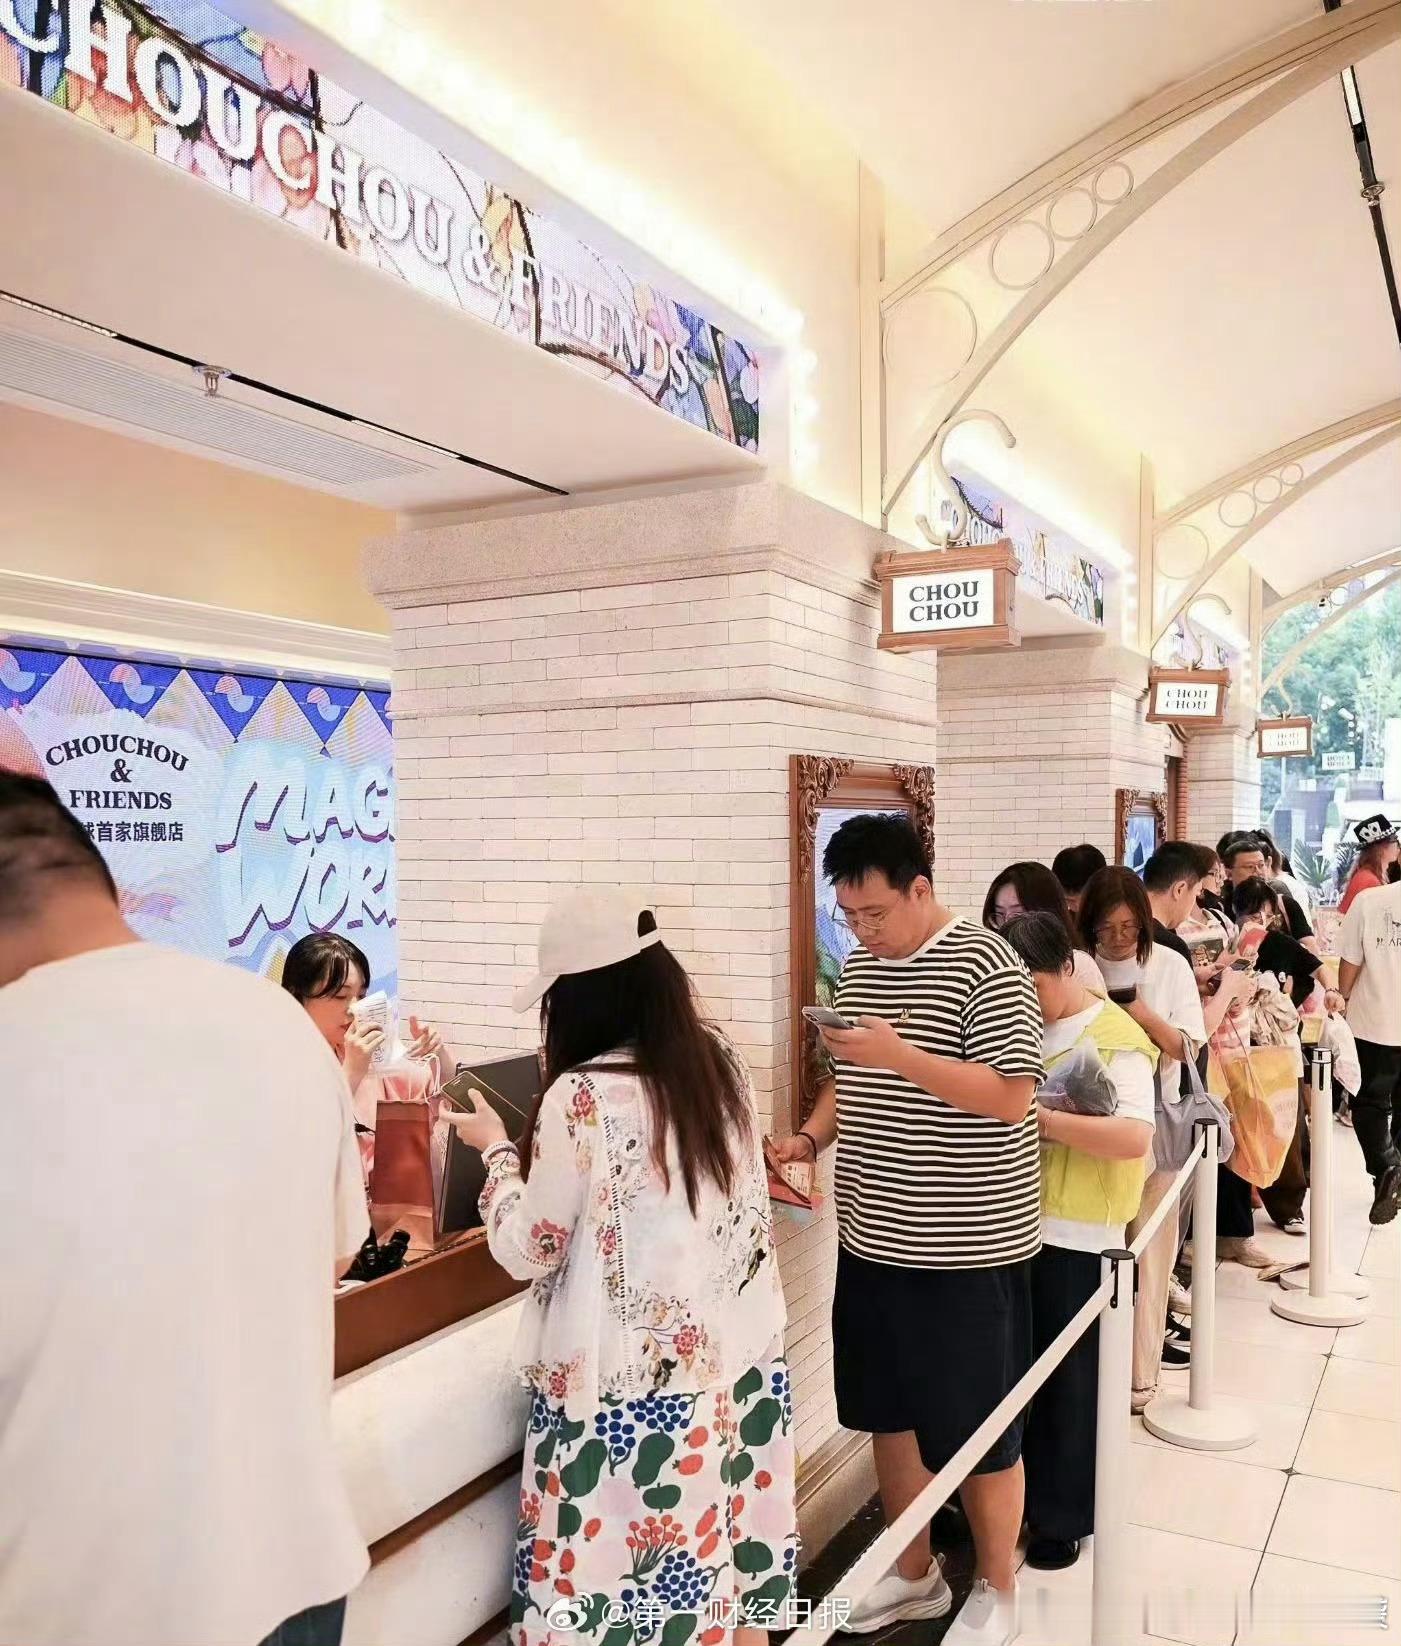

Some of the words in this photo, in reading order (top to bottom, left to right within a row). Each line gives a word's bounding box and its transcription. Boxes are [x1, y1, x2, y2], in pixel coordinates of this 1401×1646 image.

[463, 222, 502, 296] &
[508, 252, 691, 395] FRIENDS
[909, 581, 979, 602] CHOU
[909, 601, 979, 622] CHOU
[46, 734, 189, 771] CHOUCHOU
[110, 758, 133, 782] &
[69, 789, 172, 810] FRIENDS
